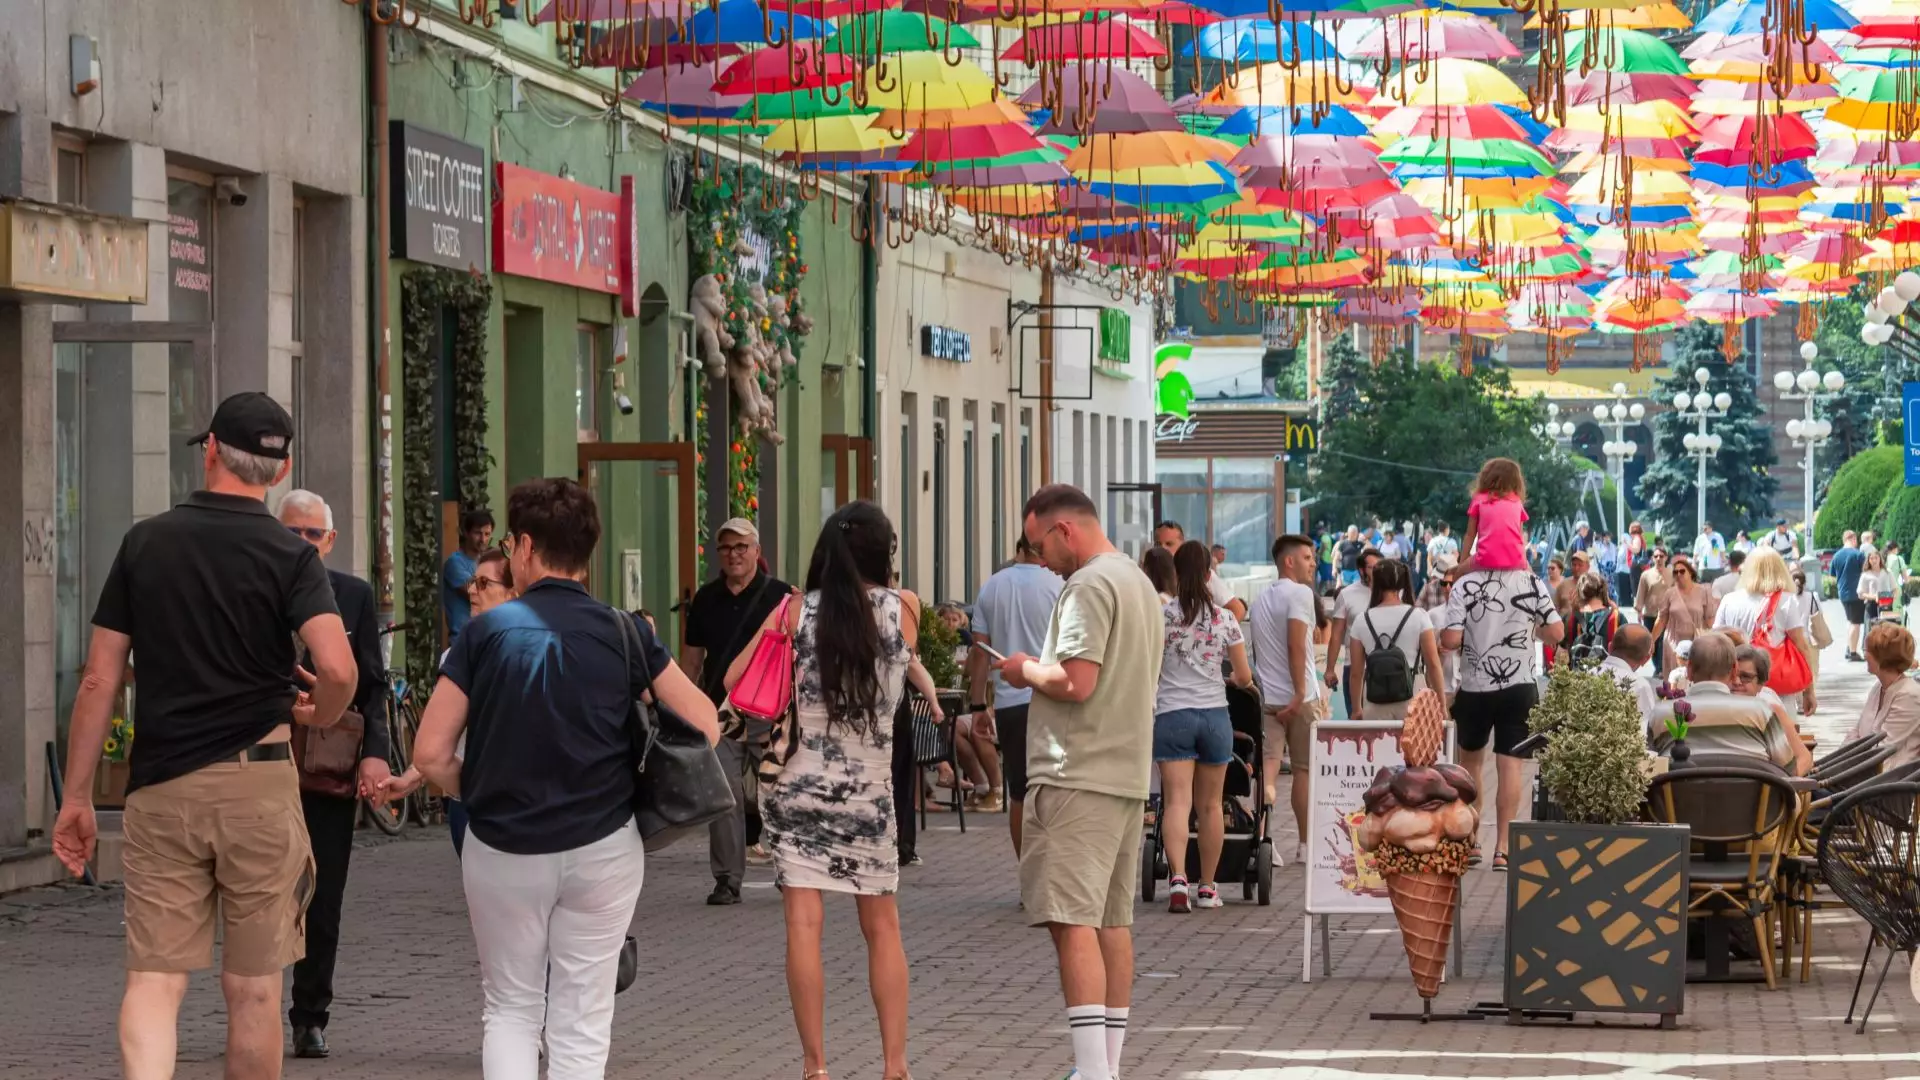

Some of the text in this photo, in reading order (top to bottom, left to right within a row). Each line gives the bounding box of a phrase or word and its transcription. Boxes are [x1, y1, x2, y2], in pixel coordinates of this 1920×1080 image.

[406, 146, 483, 223] STREET COFFEE
[432, 222, 461, 258] ROASTERS
[1321, 764, 1375, 777] DUBAI
[1340, 780, 1373, 789] Straw
